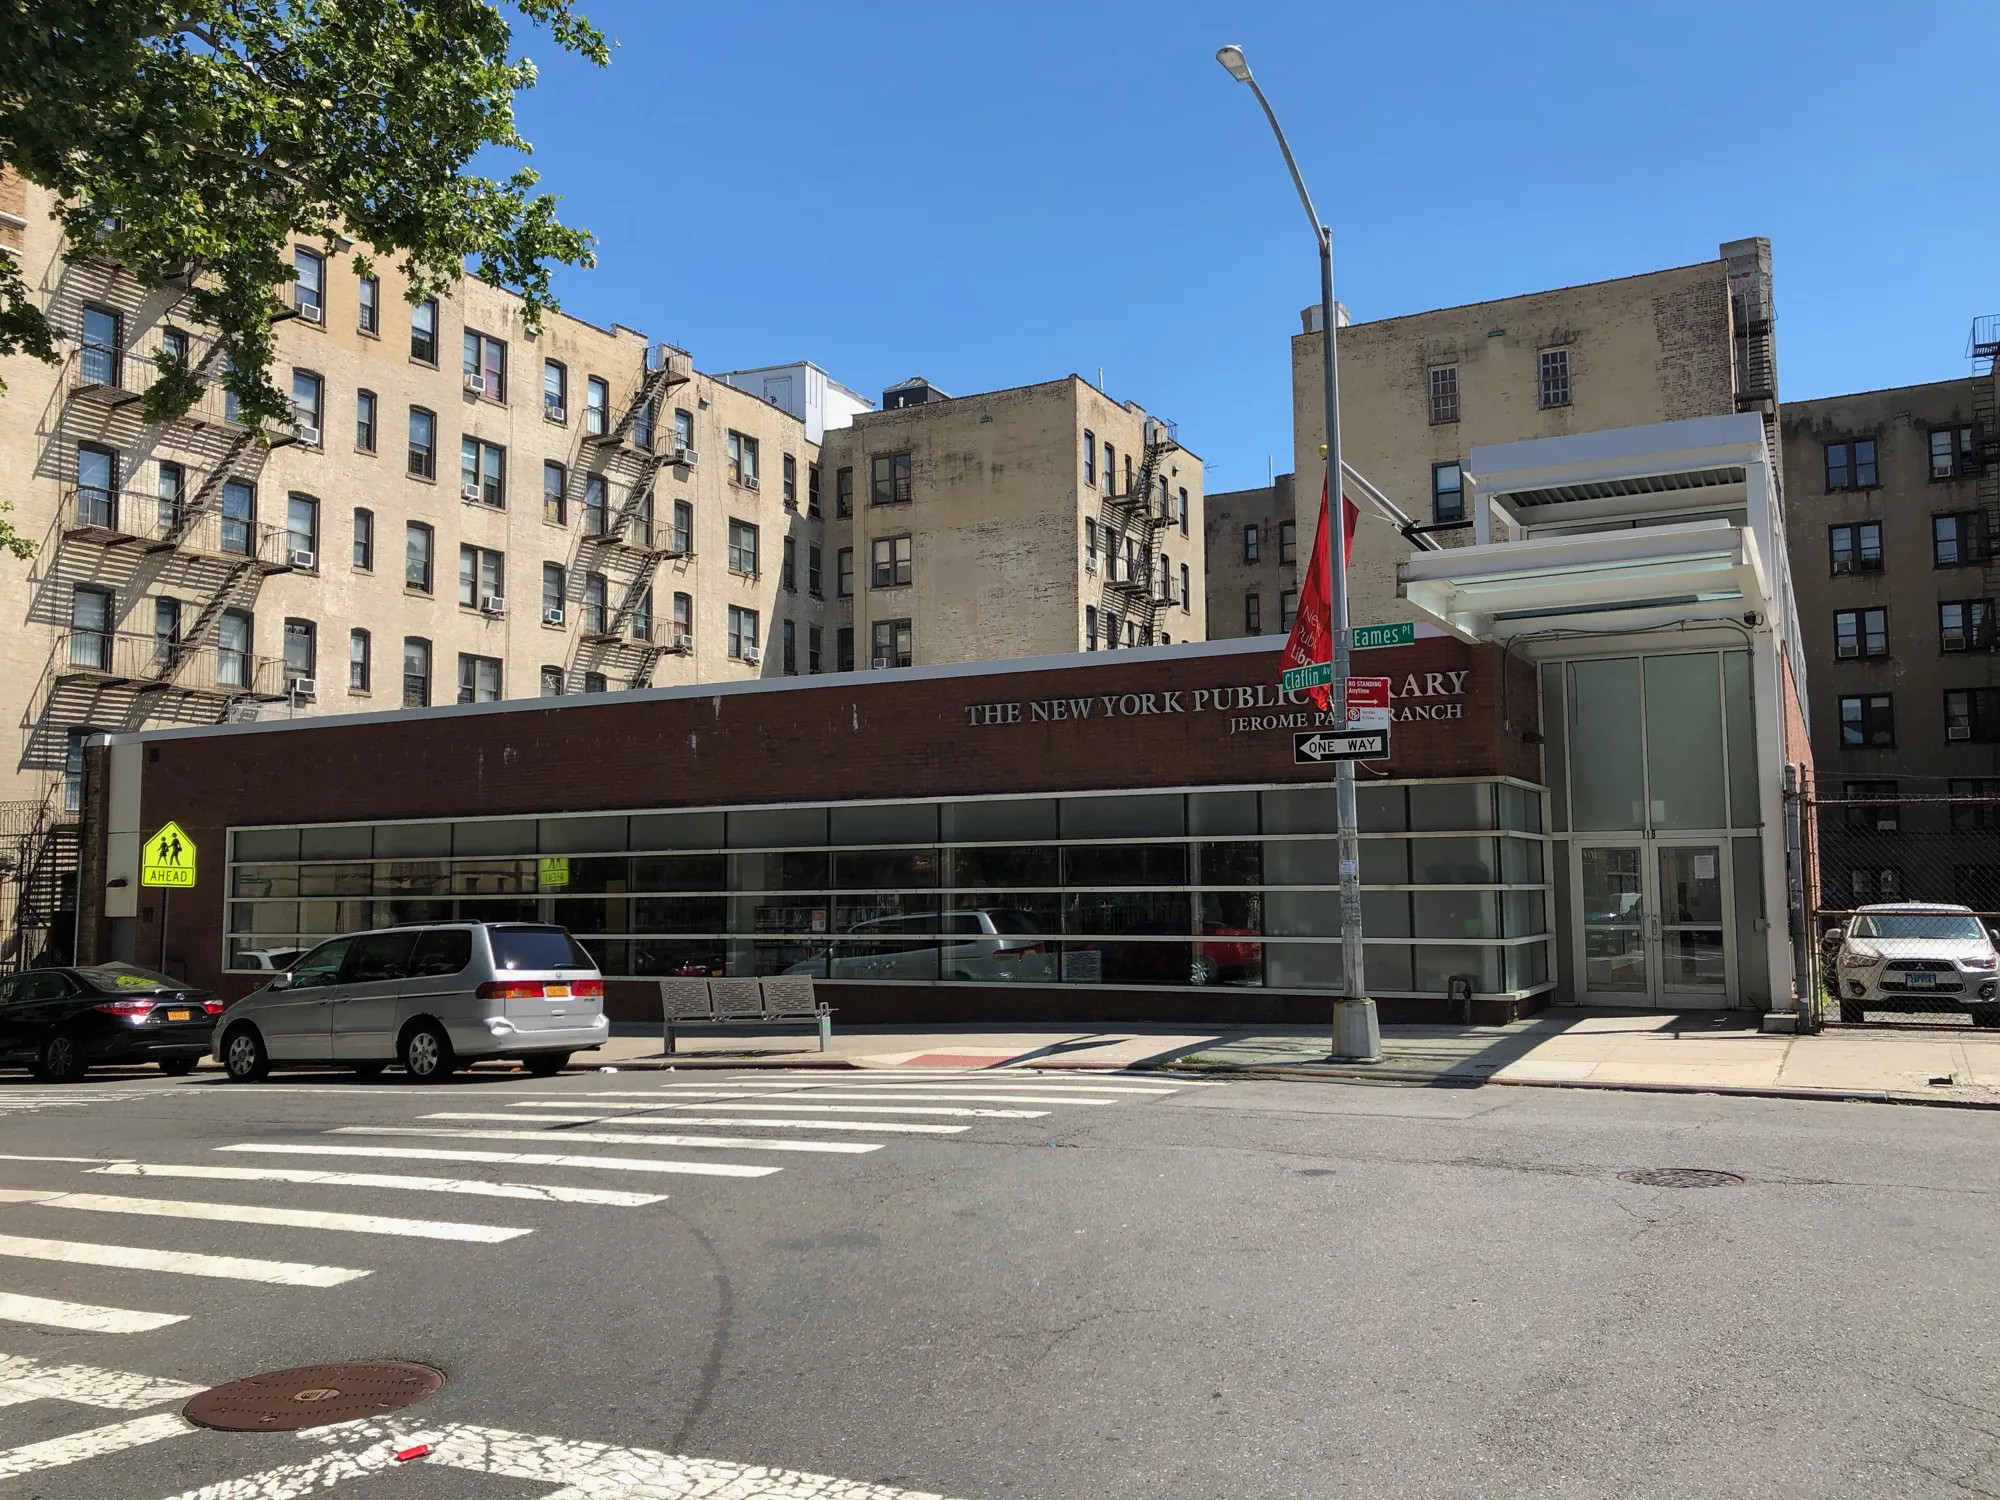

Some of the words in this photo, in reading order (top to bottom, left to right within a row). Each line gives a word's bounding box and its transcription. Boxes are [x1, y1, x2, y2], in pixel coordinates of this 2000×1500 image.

[1354, 628, 1399, 647] Eames
[1402, 625, 1411, 635] Pl
[1285, 668, 1319, 690] Claflin
[1323, 667, 1331, 676] Av
[1356, 680, 1382, 688] STANDING
[1348, 687, 1370, 695] Anytime
[964, 702, 1022, 726] THE
[1029, 697, 1095, 722] NEW
[1100, 690, 1185, 717] YORK
[1192, 683, 1309, 712] PUBLIC
[1230, 712, 1308, 735] JEROME
[1313, 711, 1335, 727] PA
[1389, 703, 1464, 722] RANCH
[1309, 741, 1335, 753] ONE
[1347, 738, 1376, 751] WAY
[1642, 829, 1656, 839] 118
[149, 869, 188, 882] AHEAD
